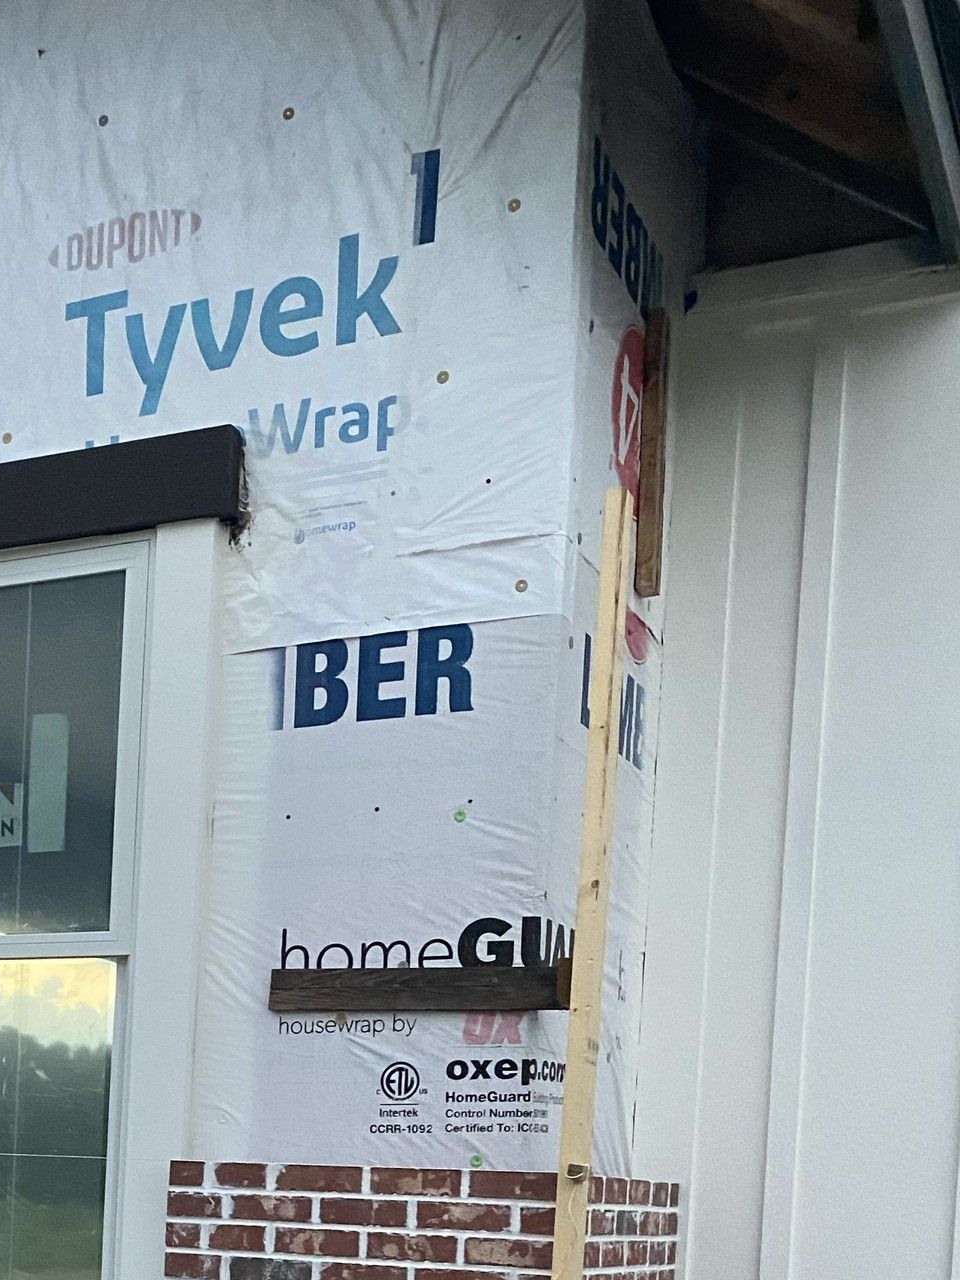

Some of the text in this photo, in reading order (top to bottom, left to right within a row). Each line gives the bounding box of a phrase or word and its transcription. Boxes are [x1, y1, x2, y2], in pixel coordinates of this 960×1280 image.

[66, 208, 182, 272] DUPONT
[65, 233, 402, 417] Tyvek
[278, 1013, 417, 1037] housewrap by
[445, 1091, 531, 1103] HomeGuard
[379, 1107, 419, 1118] Intertek
[445, 1109, 486, 1118] Control
[489, 1108, 533, 1118] Number
[369, 1124, 433, 1134] CCRR-1092
[445, 1123, 494, 1133] Certified
[497, 1124, 514, 1133] To:
